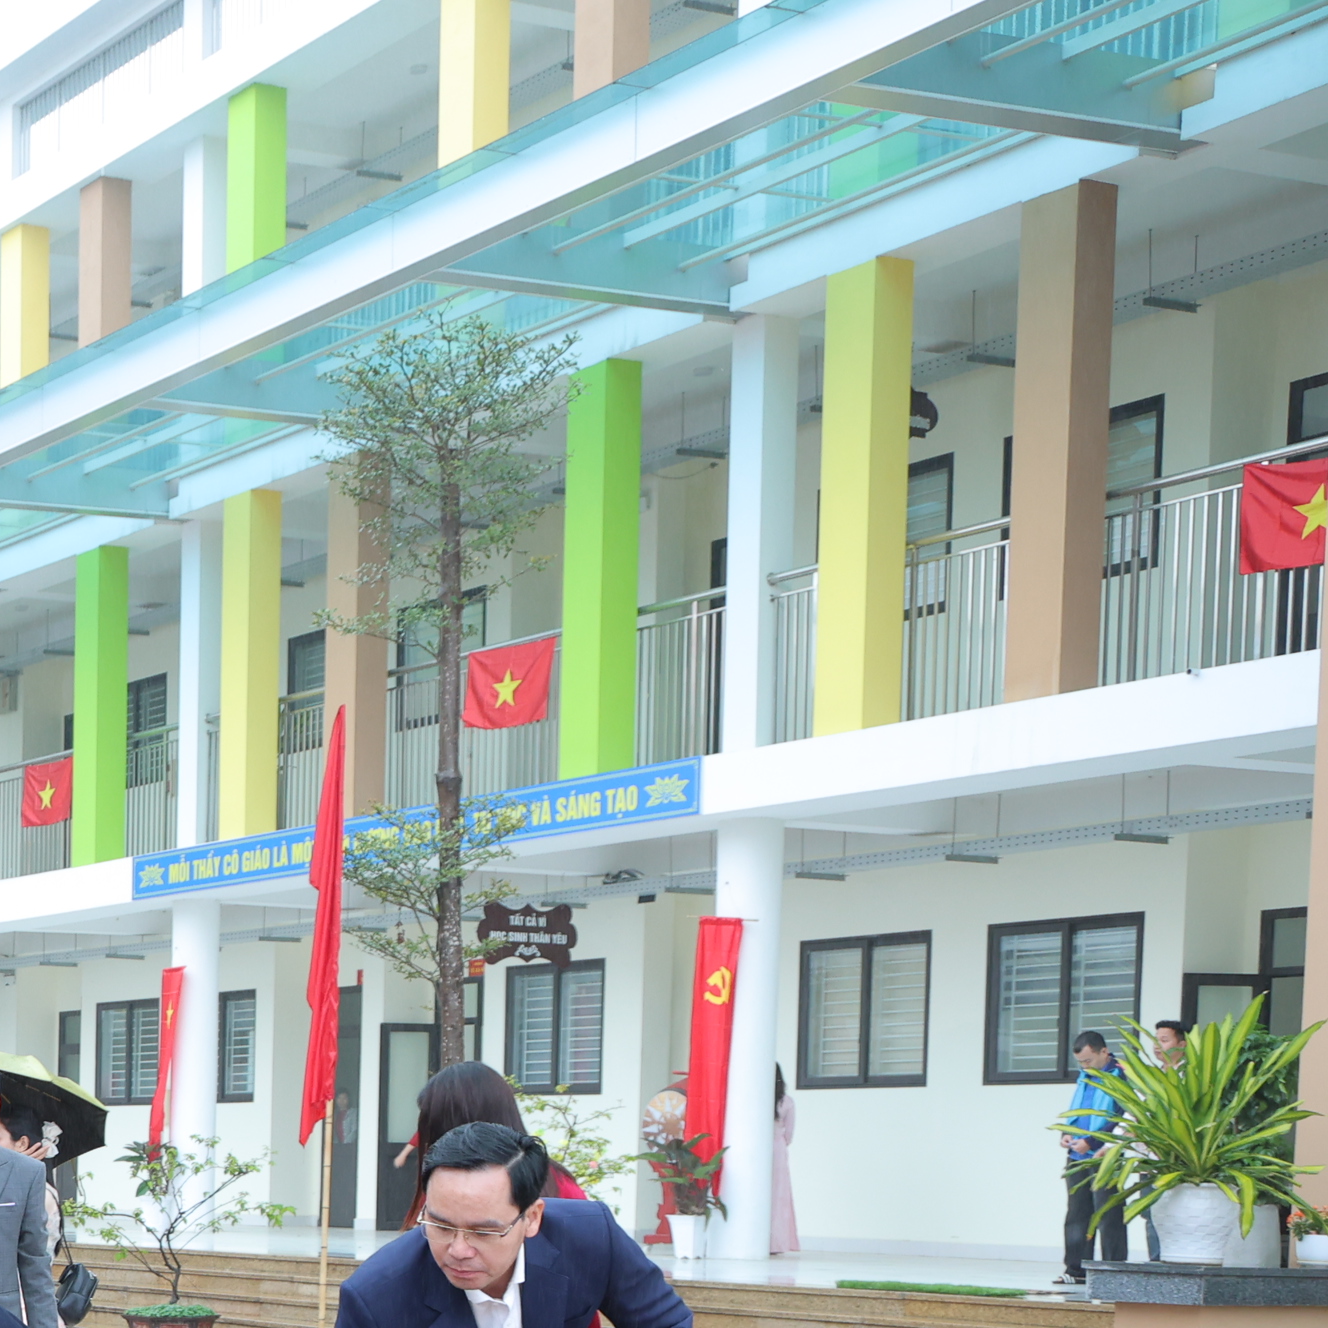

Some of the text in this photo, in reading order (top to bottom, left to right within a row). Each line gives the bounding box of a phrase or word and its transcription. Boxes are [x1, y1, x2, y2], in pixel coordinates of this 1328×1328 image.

[168, 854, 190, 884] MỖI
[223, 849, 239, 875] CÔ
[242, 845, 270, 873] GIÁO
[273, 840, 289, 868] LÀ
[292, 836, 315, 867] MỘ
[531, 795, 552, 826] VÀ
[555, 790, 602, 822] SÁNG
[605, 785, 639, 819] TẠO
[509, 912, 547, 928] TẤT CẢ VÌ
[507, 931, 528, 942] SINH
[529, 930, 551, 944] THÂN
[551, 932, 568, 945] YÊU
